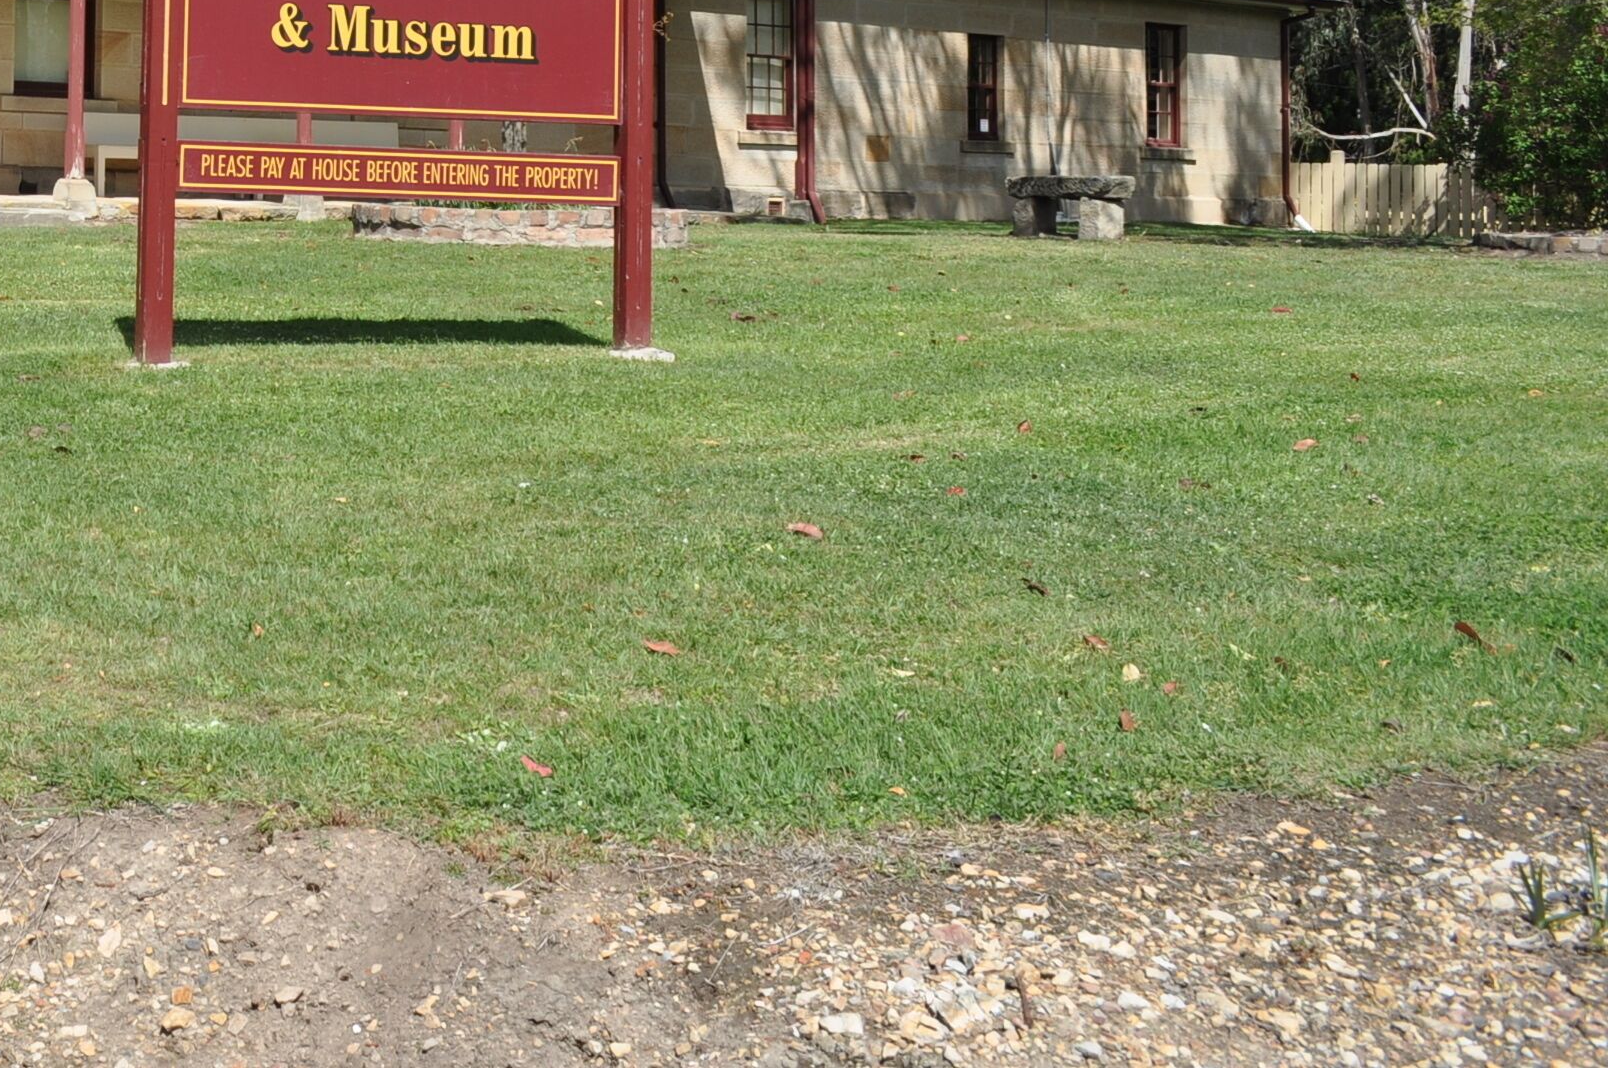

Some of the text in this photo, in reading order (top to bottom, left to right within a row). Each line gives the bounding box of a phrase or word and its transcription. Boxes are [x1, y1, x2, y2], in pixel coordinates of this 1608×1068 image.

[270, 2, 536, 61] & Museum
[200, 153, 598, 191] PLEASE PAY AT HOUSE BEFORE ENTERING THE PROPERTY!
